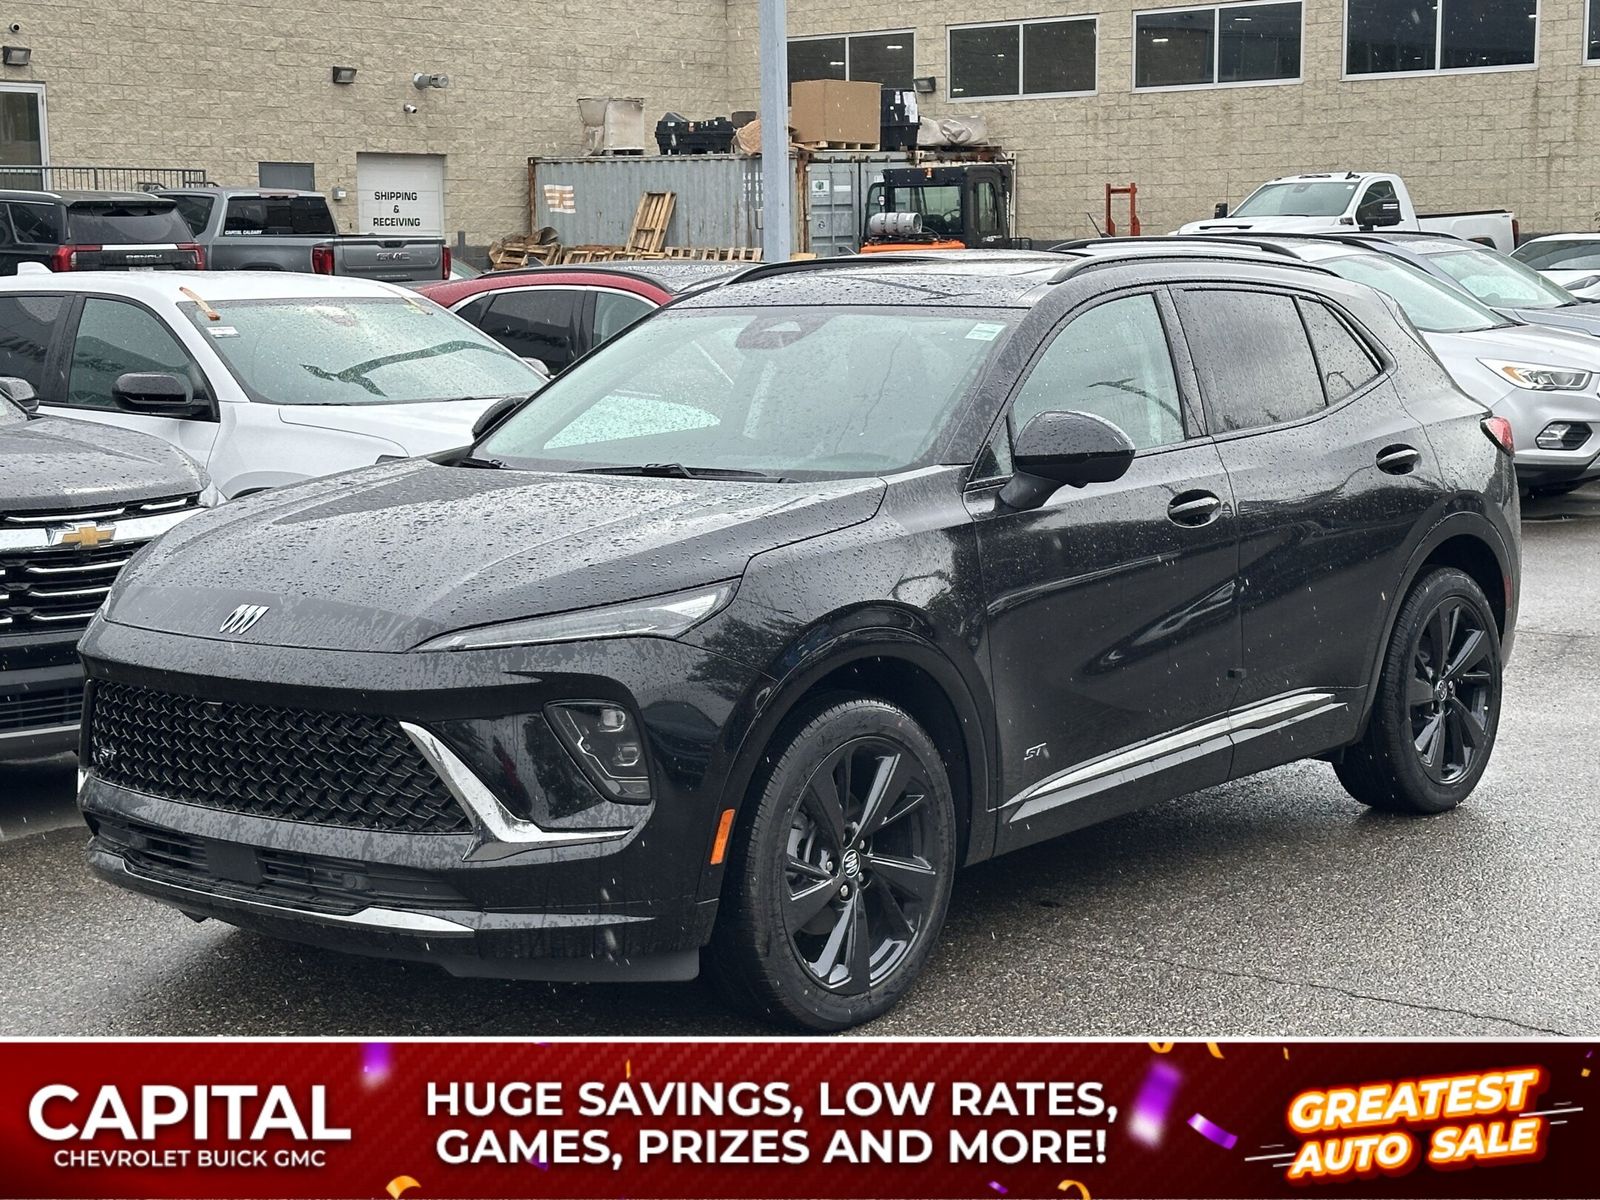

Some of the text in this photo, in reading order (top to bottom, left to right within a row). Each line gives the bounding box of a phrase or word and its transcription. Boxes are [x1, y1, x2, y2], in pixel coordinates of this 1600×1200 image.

[374, 191, 418, 201] SHIPPING
[393, 204, 400, 214] &
[373, 217, 421, 227] RECEIVING
[376, 252, 410, 261] GMC
